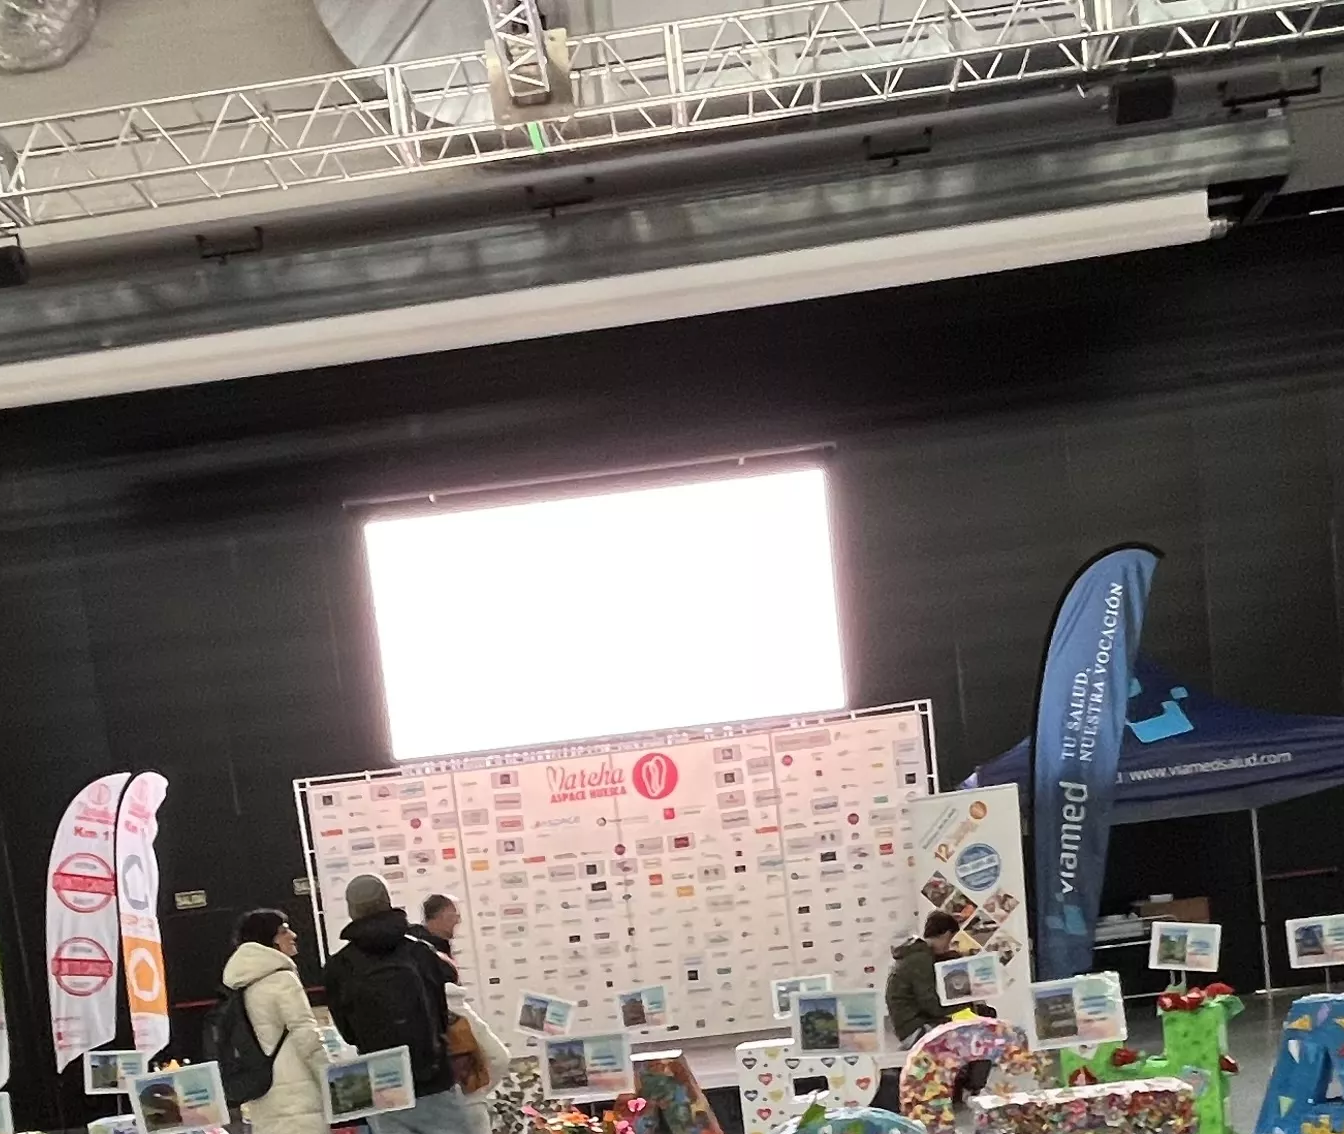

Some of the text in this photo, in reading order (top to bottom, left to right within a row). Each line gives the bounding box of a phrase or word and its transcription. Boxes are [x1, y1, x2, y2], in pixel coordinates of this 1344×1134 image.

[1061, 666, 1092, 760] TU SALUD,
[1080, 581, 1124, 762] NUESTRA VOCACIÓN
[1128, 751, 1294, 783] www.viamedsalud.com
[1058, 781, 1089, 895] viamed
